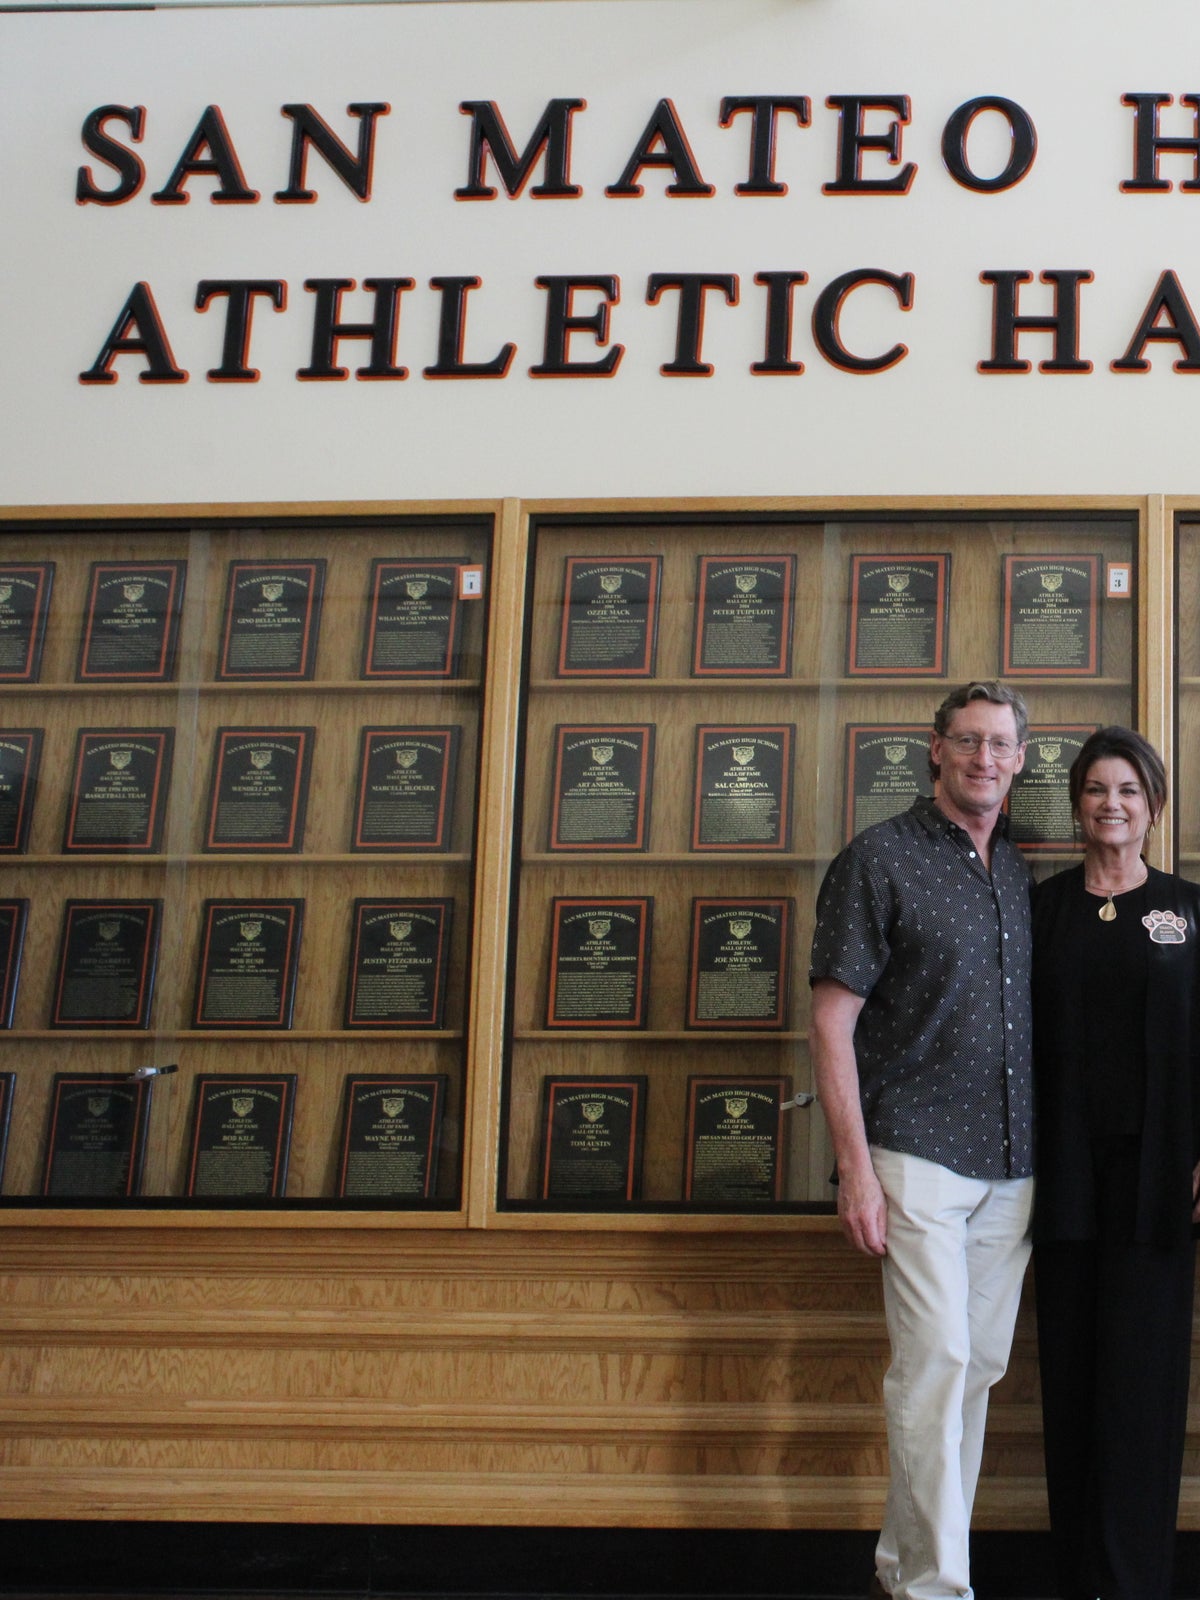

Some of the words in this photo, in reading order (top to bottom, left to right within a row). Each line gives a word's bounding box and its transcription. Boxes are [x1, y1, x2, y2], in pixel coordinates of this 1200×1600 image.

[75, 103, 391, 207] SAN
[454, 95, 1037, 202] MATEO
[78, 269, 915, 385] ATHLETIC
[363, 957, 387, 965] JUSTIN
[387, 957, 433, 965] FITZGERALD
[714, 956, 728, 964] JOE
[729, 956, 763, 964] SWEENEY
